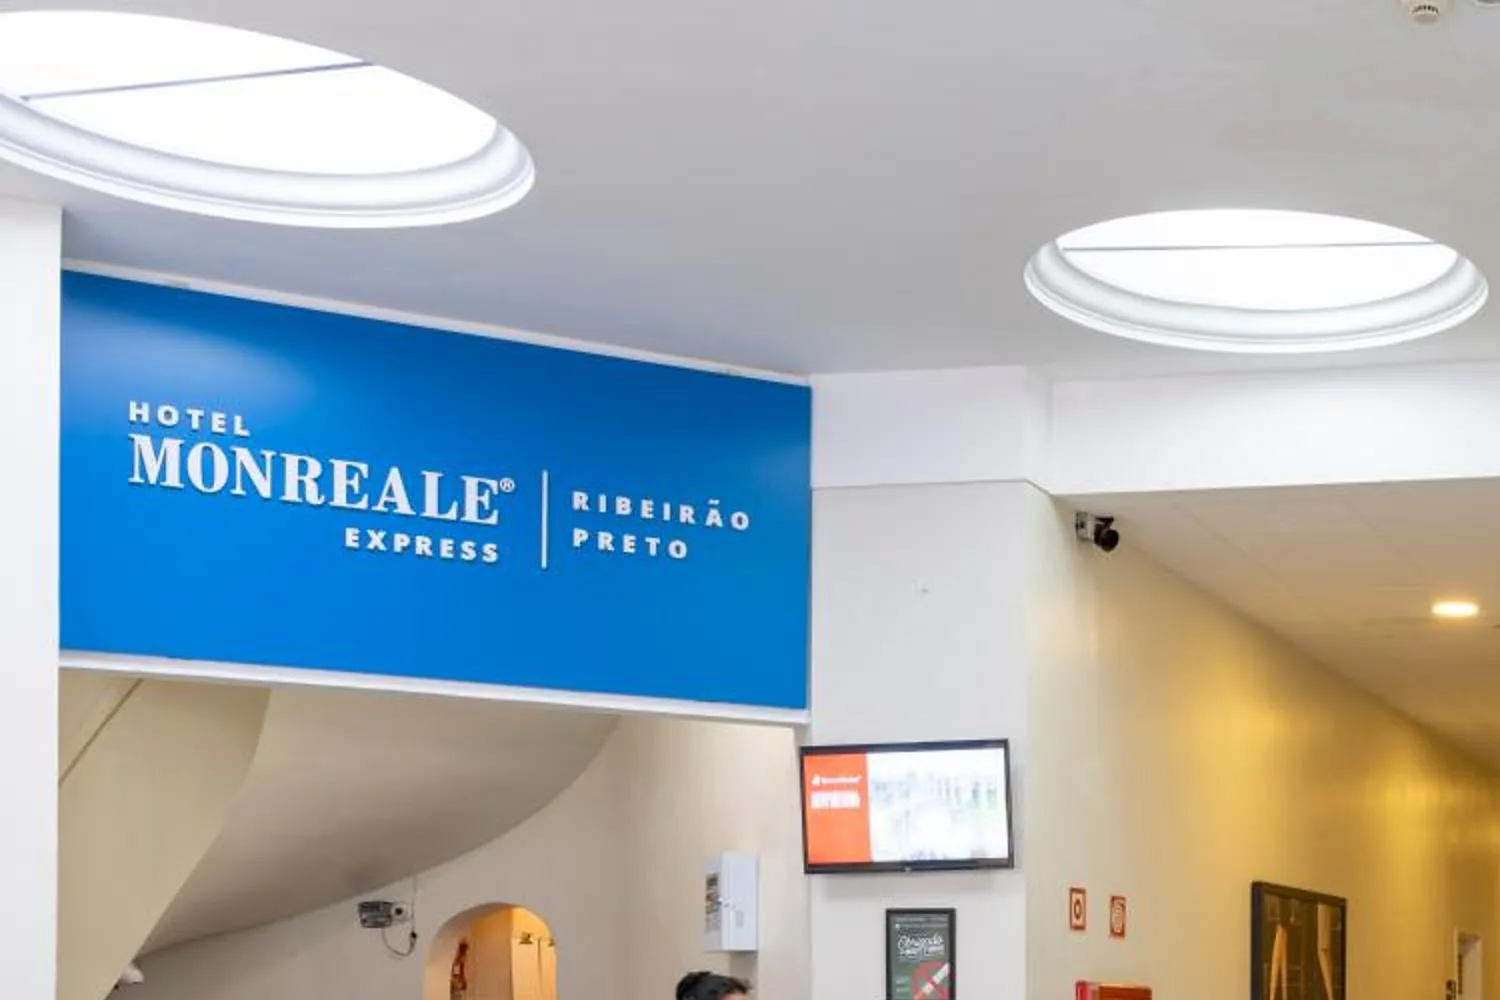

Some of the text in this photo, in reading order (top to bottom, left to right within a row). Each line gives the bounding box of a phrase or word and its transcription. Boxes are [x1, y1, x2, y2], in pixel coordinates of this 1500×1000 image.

[129, 401, 250, 437] HOTEL
[573, 490, 750, 531] RIBEIRÃO
[344, 527, 499, 563] EXPRESS
[573, 528, 688, 559] PRETO
